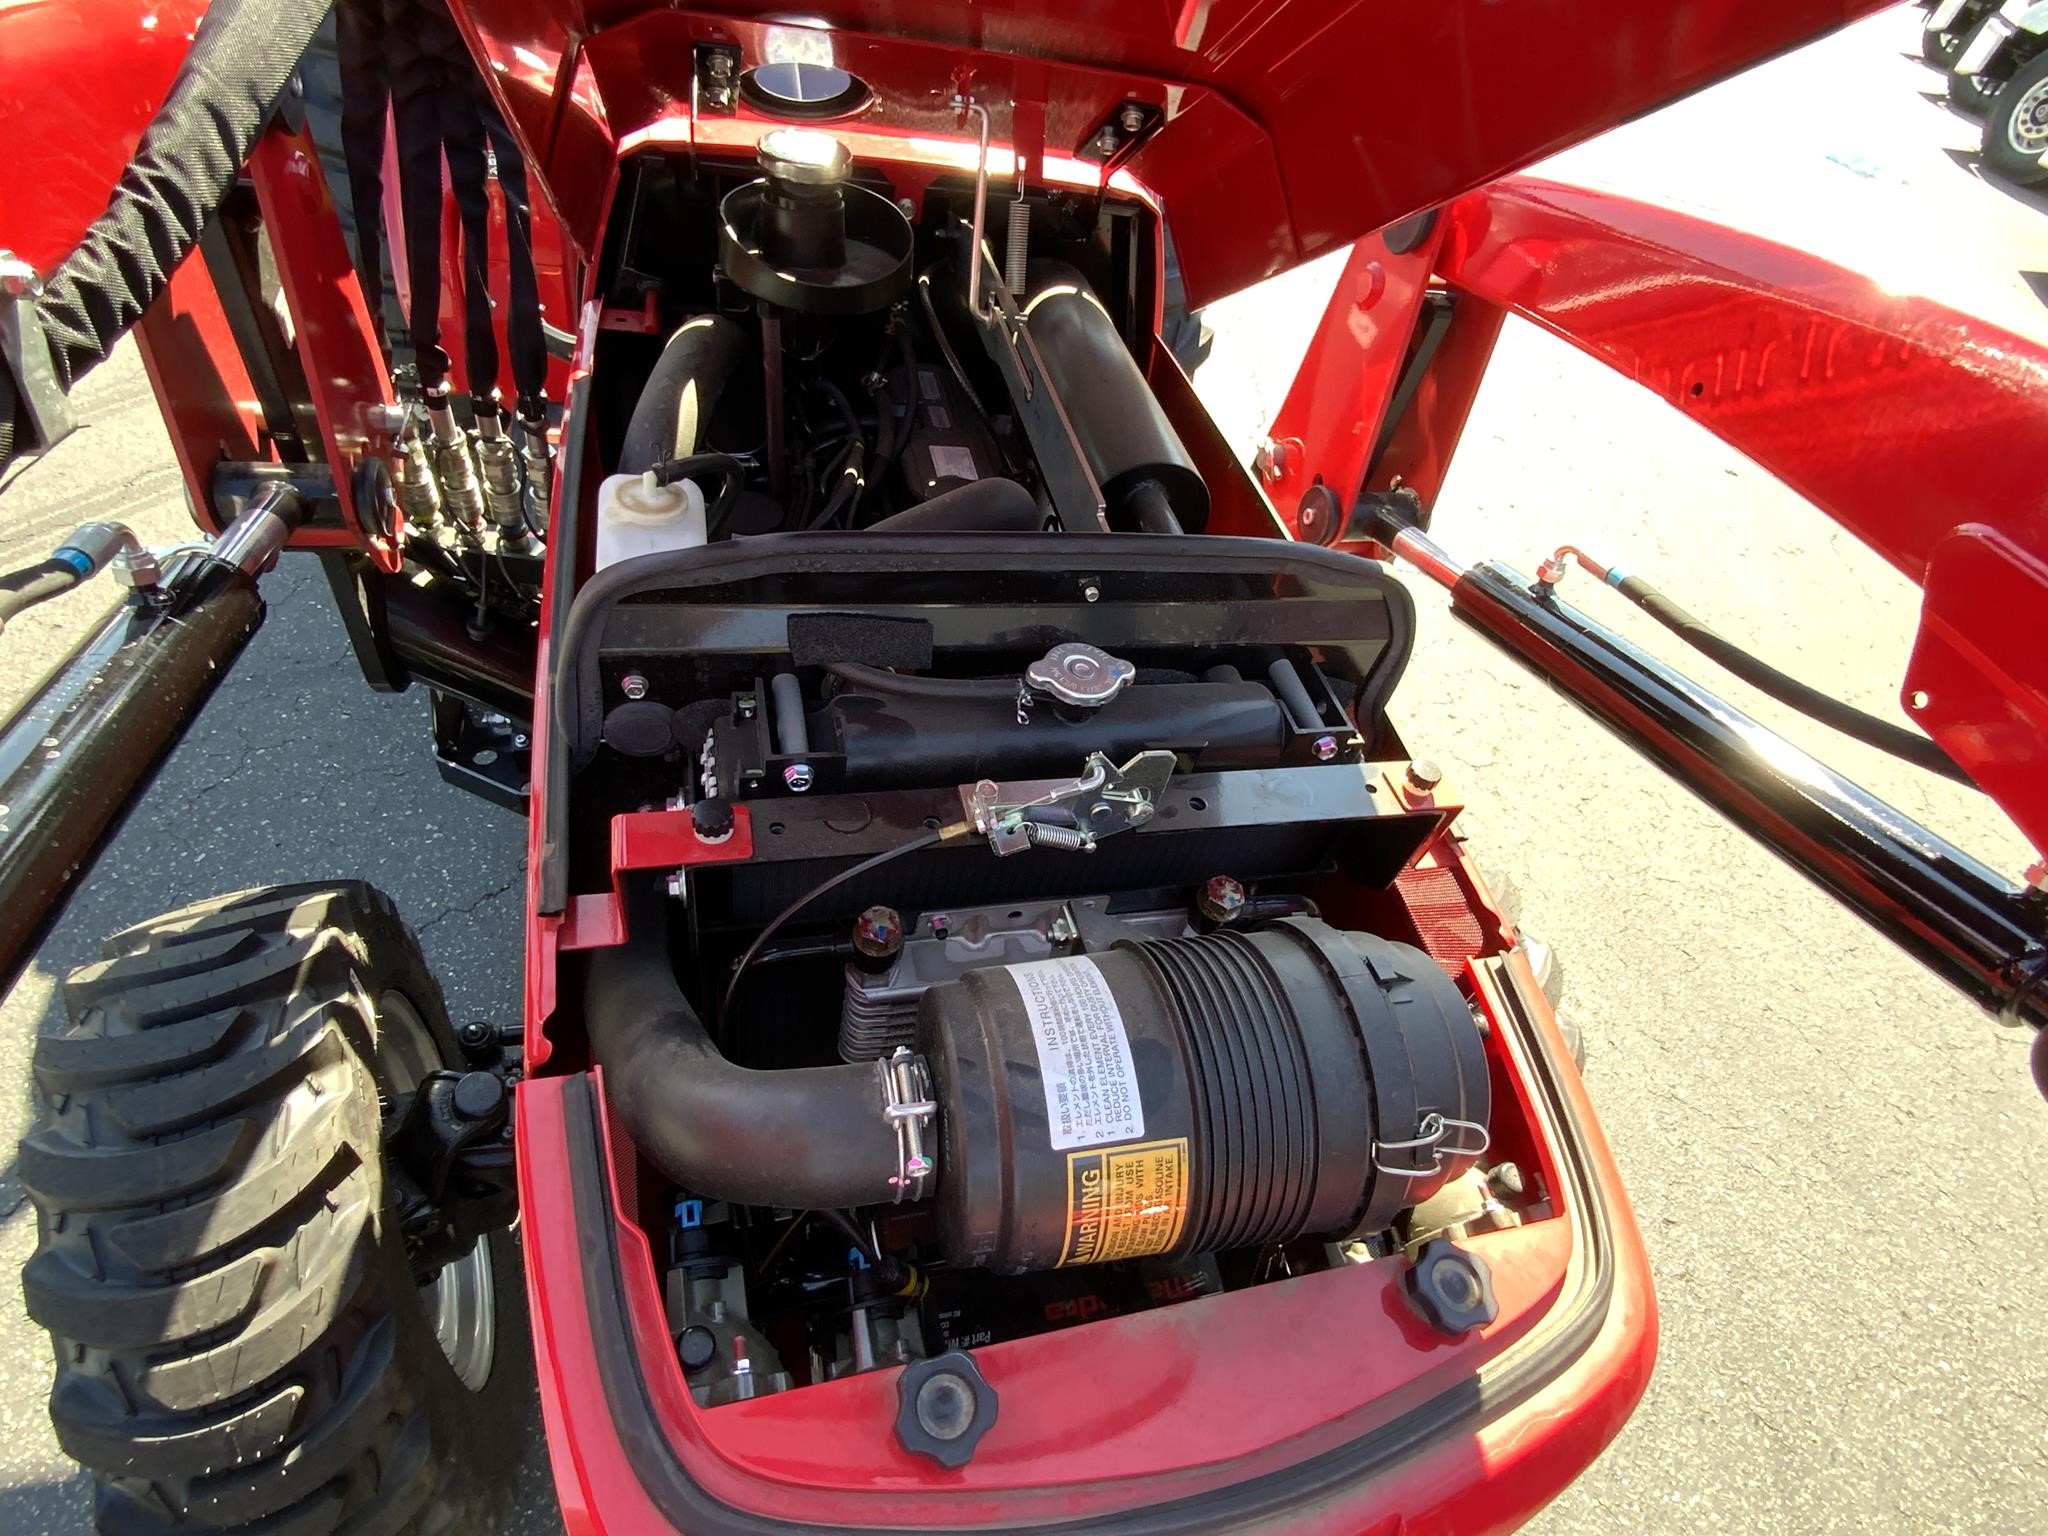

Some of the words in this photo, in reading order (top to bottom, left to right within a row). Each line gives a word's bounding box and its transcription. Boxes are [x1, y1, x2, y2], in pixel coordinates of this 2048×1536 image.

[1023, 972, 1059, 1050] INSTRUCTIONS
[1077, 998, 1088, 1010] 100
[1082, 988, 1098, 1011] DUSTY
[1096, 997, 1113, 1032] WITHOUT
[1083, 1013, 1097, 1039] EVERY
[1092, 1012, 1104, 1030] FOR
[1091, 1042, 1108, 1085] ELEMENT
[1098, 1032, 1114, 1077] INTERVAL
[1107, 1034, 1124, 1077] OPERATE
[1101, 1088, 1113, 1123] CLEAN
[1108, 1079, 1123, 1121] REDUCE
[1118, 1080, 1129, 1102] NOT
[1122, 1104, 1132, 1120] DO
[1115, 1163, 1124, 1204] INJURY
[1154, 1156, 1163, 1206] GASOLINE
[1075, 1168, 1100, 1255] WARNING
[1117, 1223, 1130, 1248] RESULT
[1125, 1161, 1133, 1184] USE
[971, 1330, 991, 1345] Part
